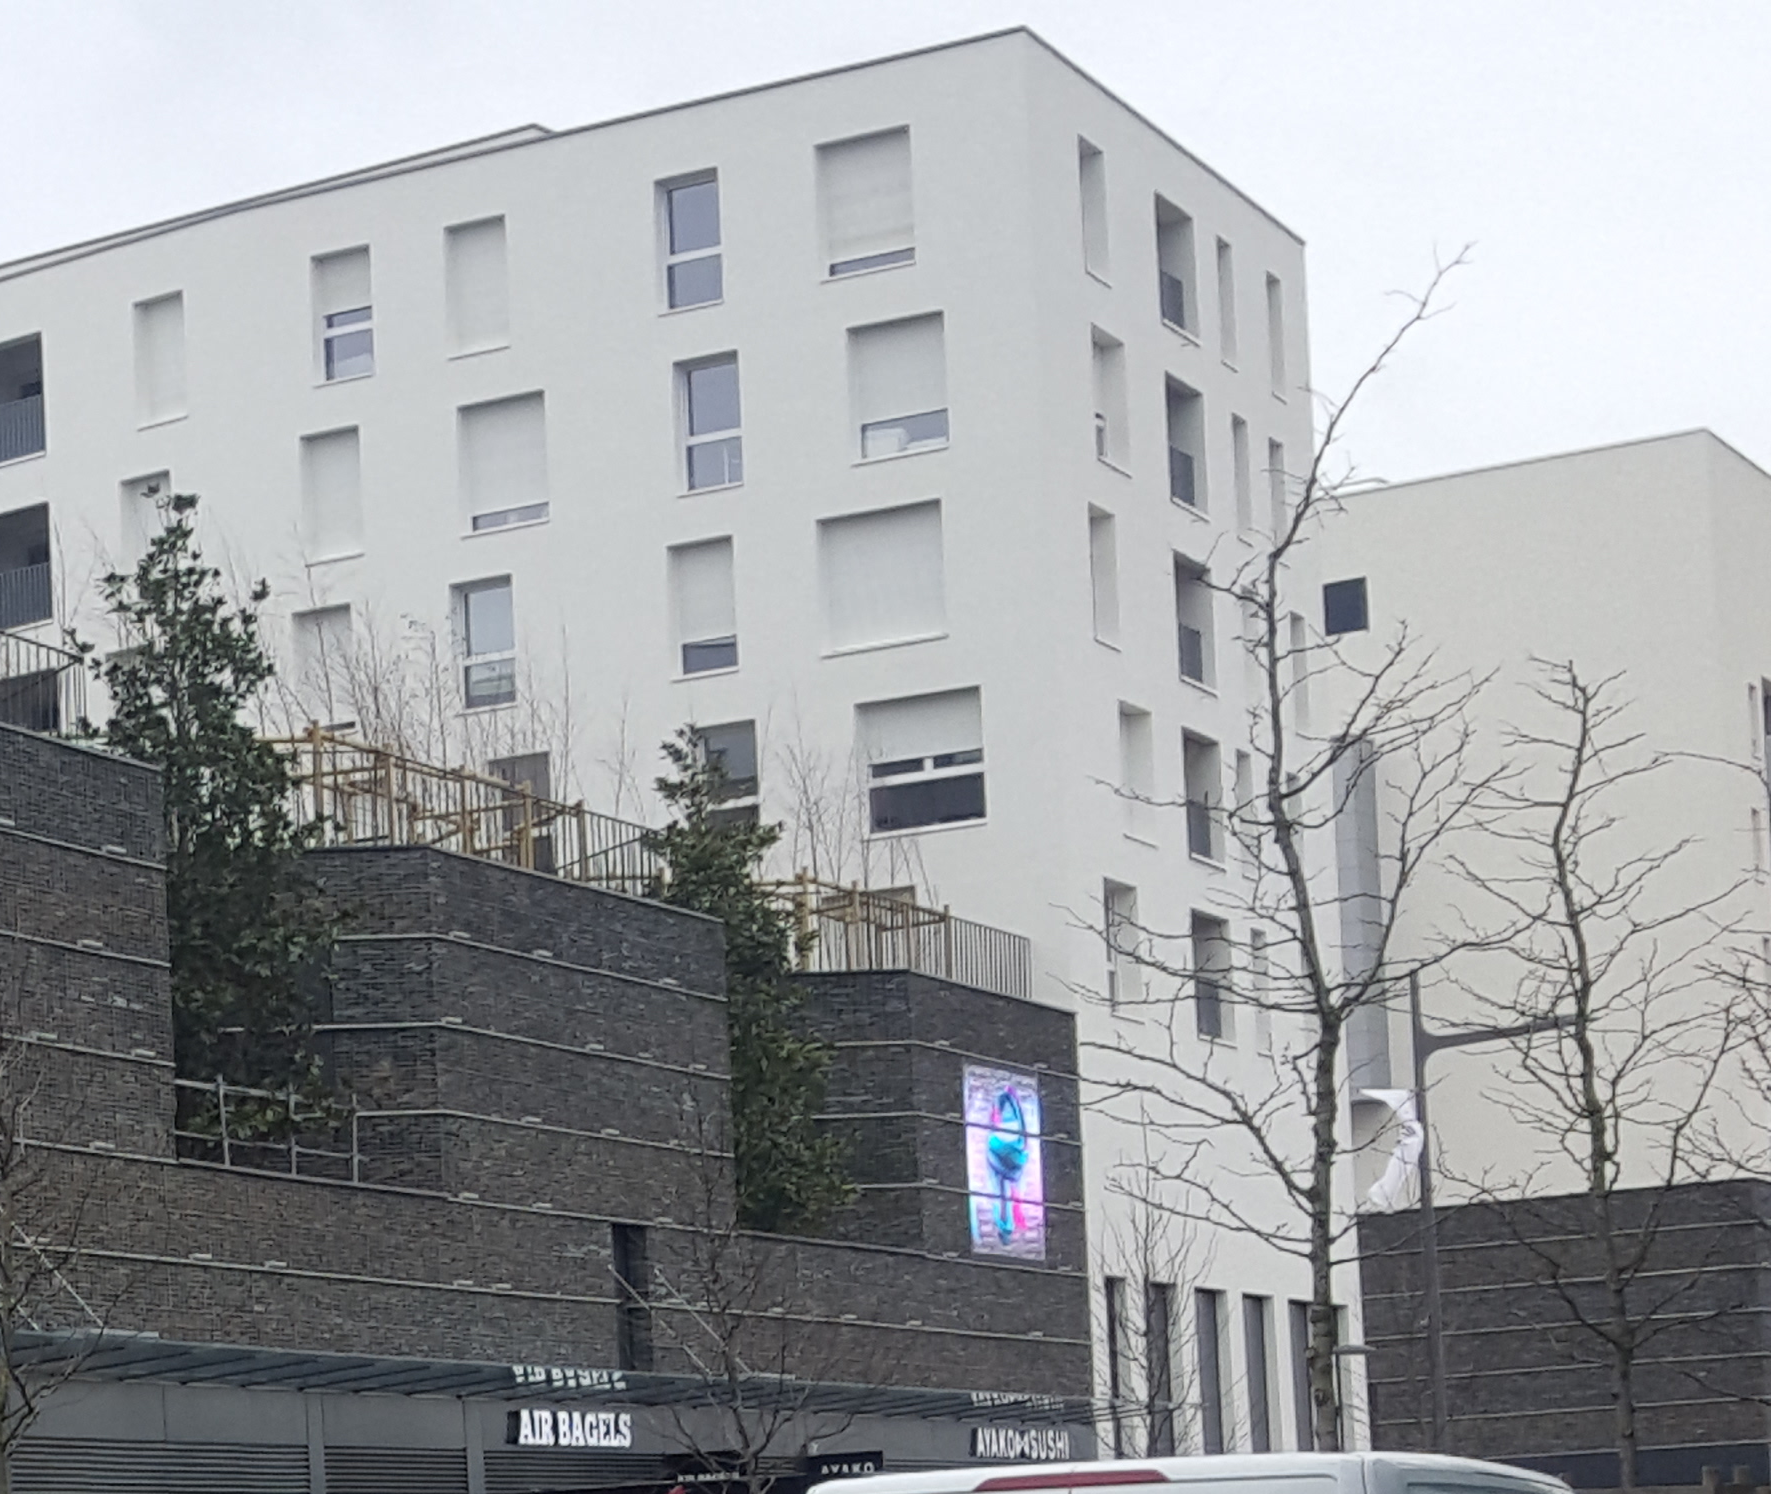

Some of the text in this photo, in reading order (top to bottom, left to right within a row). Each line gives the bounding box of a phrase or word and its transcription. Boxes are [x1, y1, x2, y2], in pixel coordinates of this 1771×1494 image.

[518, 1408, 632, 1448] AIR BAGELS
[977, 1427, 1070, 1460] AYAKO SUSHI
